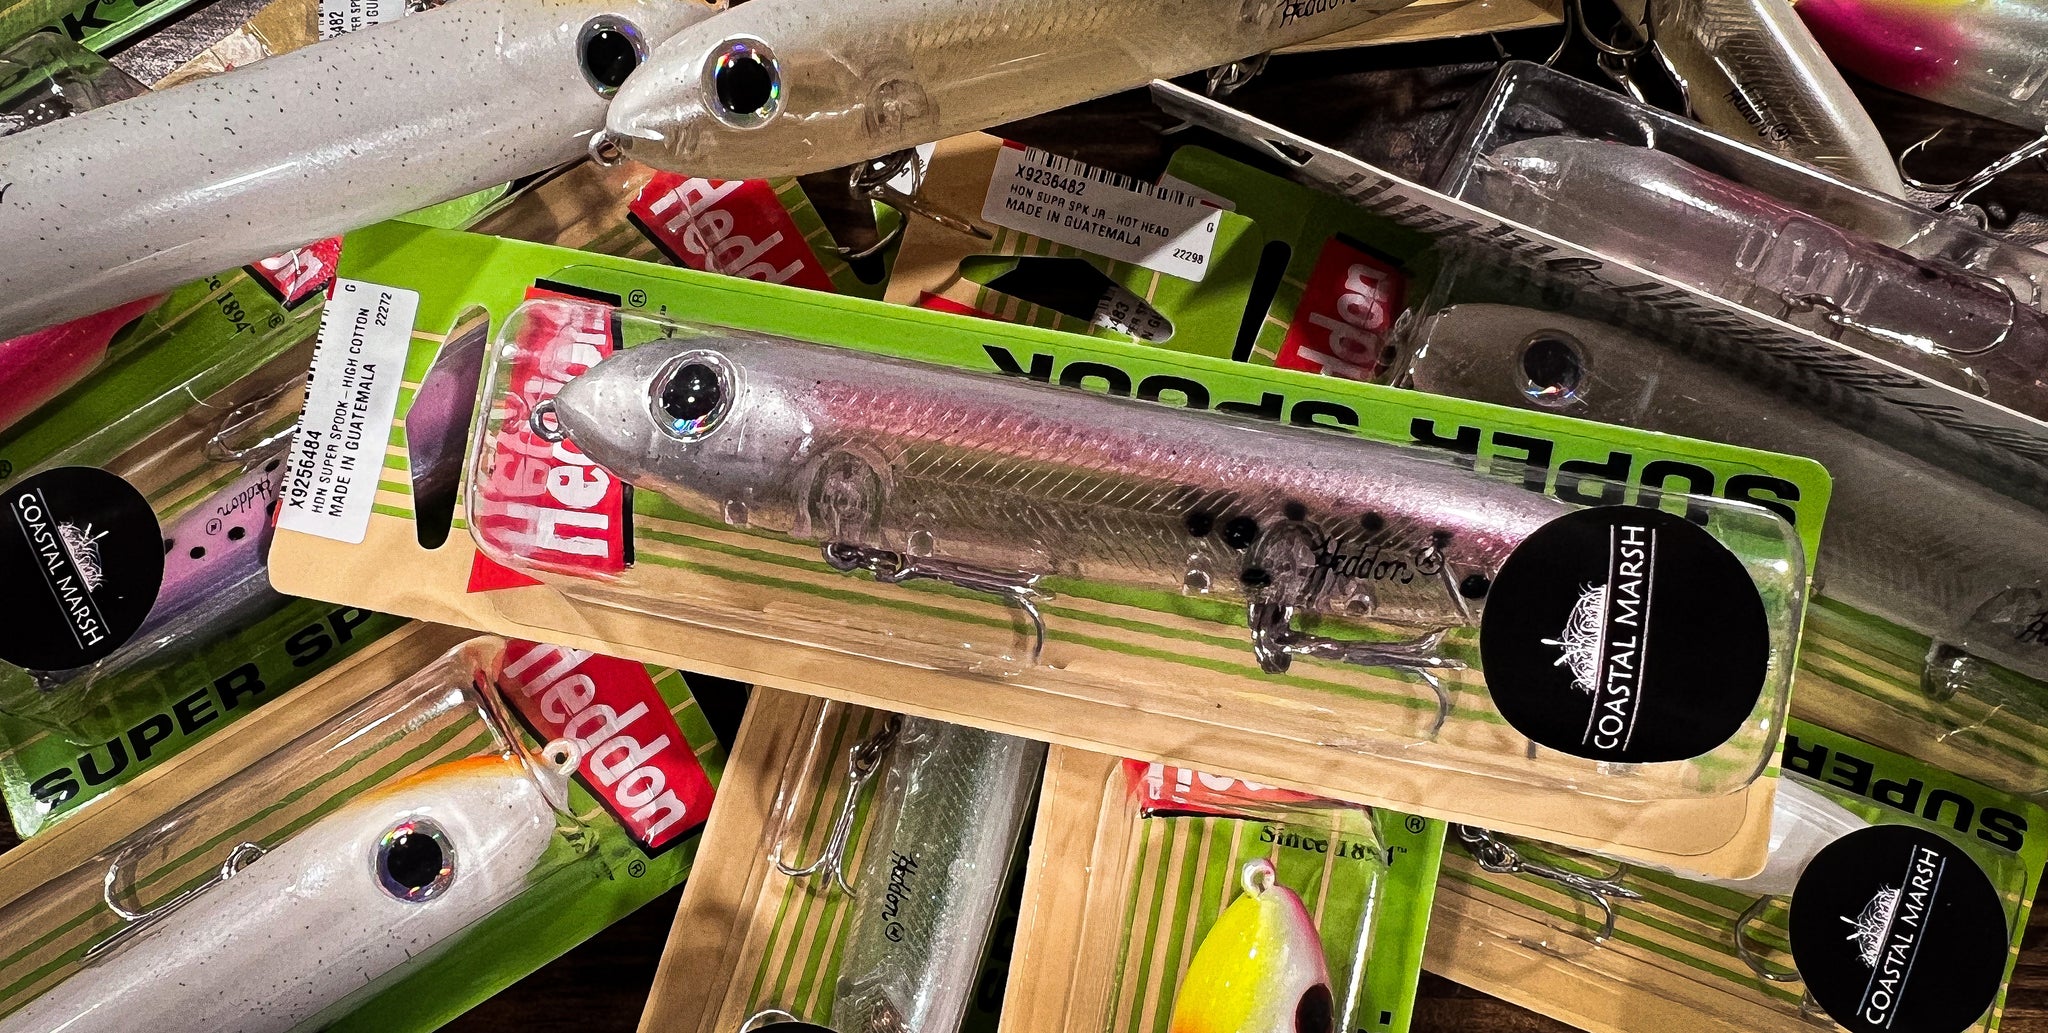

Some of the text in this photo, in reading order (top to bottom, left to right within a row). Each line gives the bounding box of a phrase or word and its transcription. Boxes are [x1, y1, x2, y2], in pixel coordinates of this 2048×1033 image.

[1005, 197, 1042, 218] MADE
[1046, 209, 1060, 223] IN
[1063, 214, 1143, 246] GUATEMALA
[1068, 200, 1089, 215] SPK
[1116, 214, 1138, 228] HOT
[1140, 221, 1170, 237] HEAD
[288, 283, 356, 509] X9256484 G
[341, 357, 358, 388] HIGH
[349, 307, 370, 354] COTTON
[319, 443, 339, 484] SUPER
[328, 291, 392, 518] MADE IN GUATEMALA 22272
[329, 400, 349, 440] SPOOK
[18, 493, 104, 646] COASTAL MARSH
[1594, 525, 1645, 750] COASTAL MARSH
[30, 662, 266, 806] SUPER
[502, 643, 687, 838] Heddon
[1781, 735, 2028, 853] SUPER
[1865, 847, 1940, 1025] COASTAL MARSH
